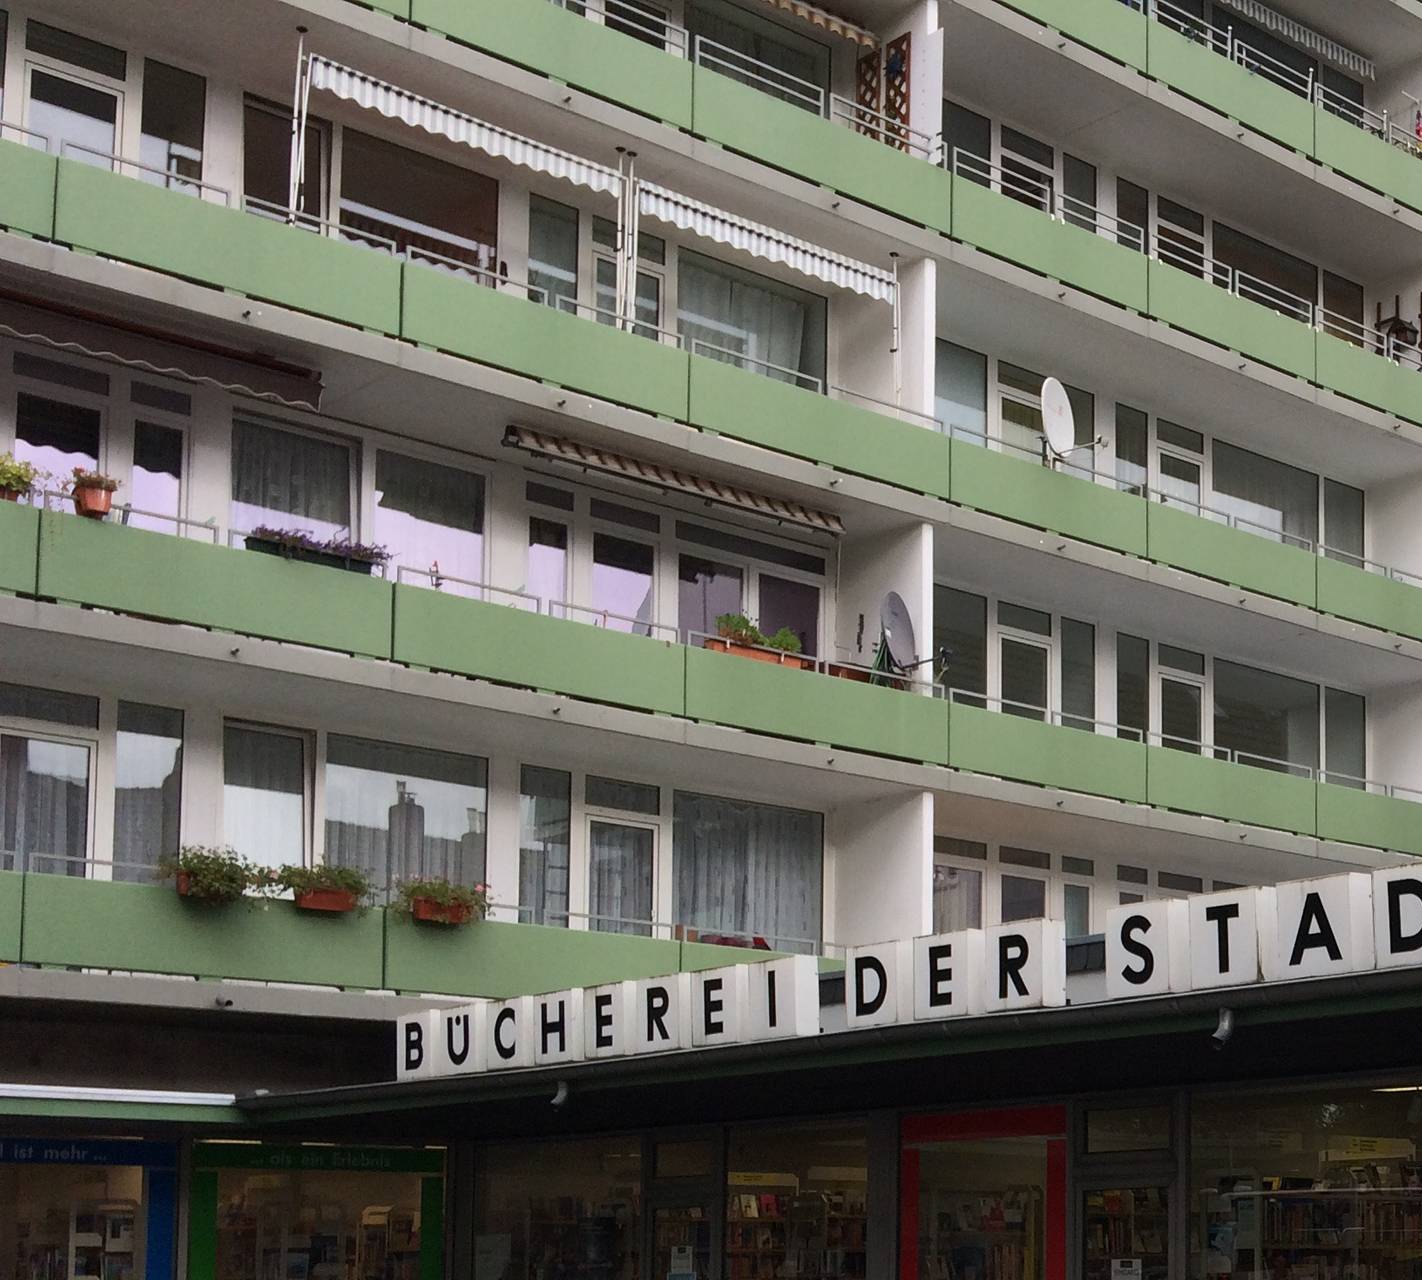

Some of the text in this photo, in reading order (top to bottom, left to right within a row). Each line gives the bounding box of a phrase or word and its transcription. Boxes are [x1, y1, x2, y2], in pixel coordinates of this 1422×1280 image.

[405, 969, 778, 1070] BÜCHEREI
[854, 935, 1030, 1016] DER
[44, 1144, 88, 1161] mehr
